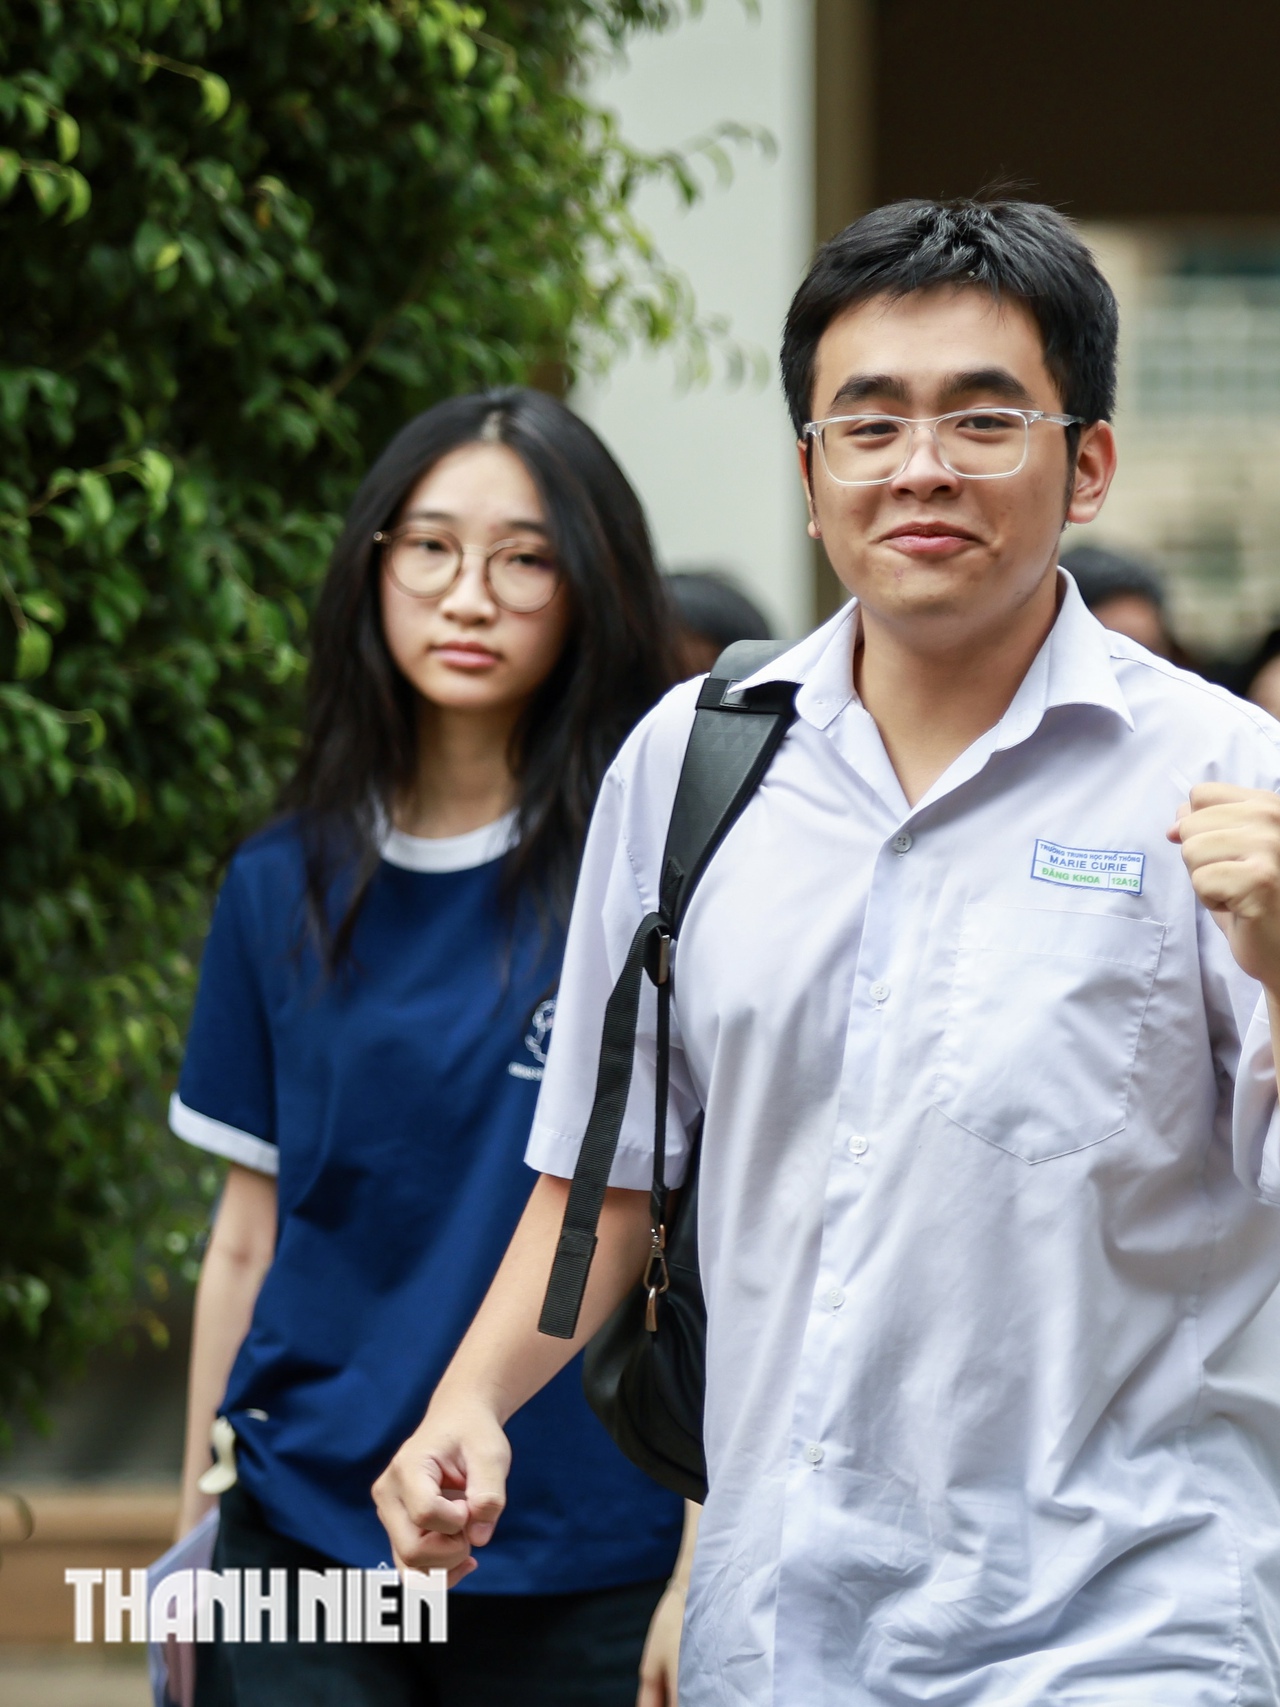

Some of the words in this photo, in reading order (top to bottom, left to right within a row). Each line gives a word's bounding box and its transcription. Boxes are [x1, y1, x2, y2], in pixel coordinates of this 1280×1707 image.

[1049, 855, 1087, 869] MARIE
[1091, 861, 1128, 872] CURIE
[1066, 851, 1088, 860] TRUNG
[1089, 854, 1103, 862] HỌC
[1119, 854, 1141, 863] THÔNG
[1041, 867, 1070, 881] ĐĂNG
[1072, 874, 1101, 884] KHOA
[1111, 877, 1139, 888] 12A12
